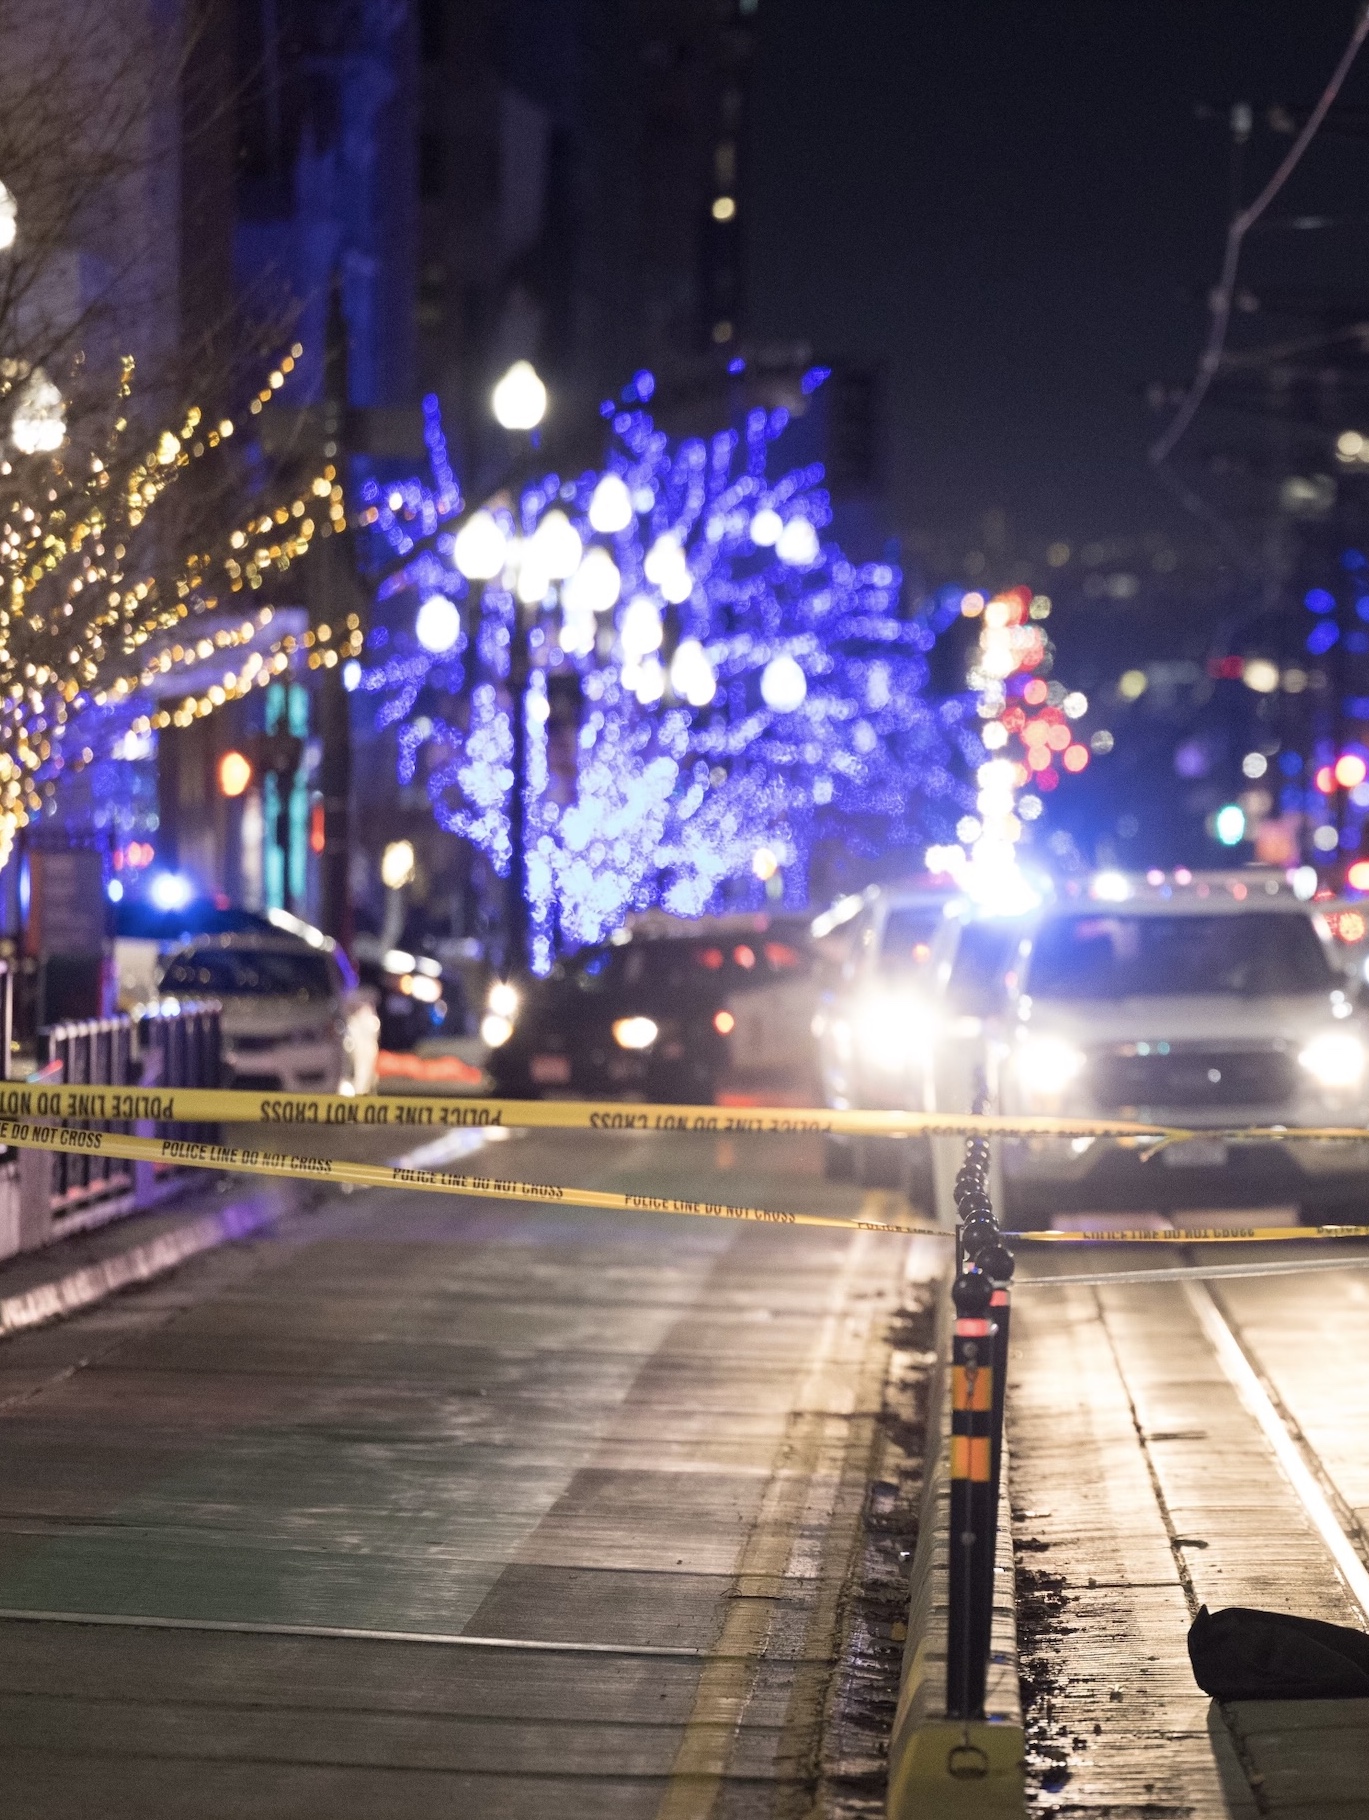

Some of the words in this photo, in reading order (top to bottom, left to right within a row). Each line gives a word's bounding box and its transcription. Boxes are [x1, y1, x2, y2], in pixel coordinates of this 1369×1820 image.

[37, 1092, 61, 1116] DO
[68, 1093, 105, 1118] LINE
[112, 1095, 174, 1119] POLICE
[261, 1100, 318, 1123] CROSS
[327, 1102, 359, 1123] NOT
[364, 1104, 388, 1124] DO
[395, 1106, 433, 1124] LINE
[440, 1107, 502, 1125] POLICE
[11, 1124, 29, 1141] DO
[32, 1126, 58, 1144] NOT
[60, 1129, 102, 1149] CROSS
[162, 1141, 207, 1159] POLICE
[210, 1146, 237, 1164] LINE
[242, 1150, 259, 1165] DO
[262, 1152, 288, 1168] NOT
[290, 1155, 332, 1173] CROSS
[393, 1168, 436, 1184] POLICE
[441, 1173, 467, 1187] LINE
[473, 1177, 490, 1189] DO
[494, 1179, 518, 1191] NOT
[522, 1183, 563, 1198] CROSS
[625, 1194, 669, 1210] POLICE
[673, 1199, 700, 1213] LINE
